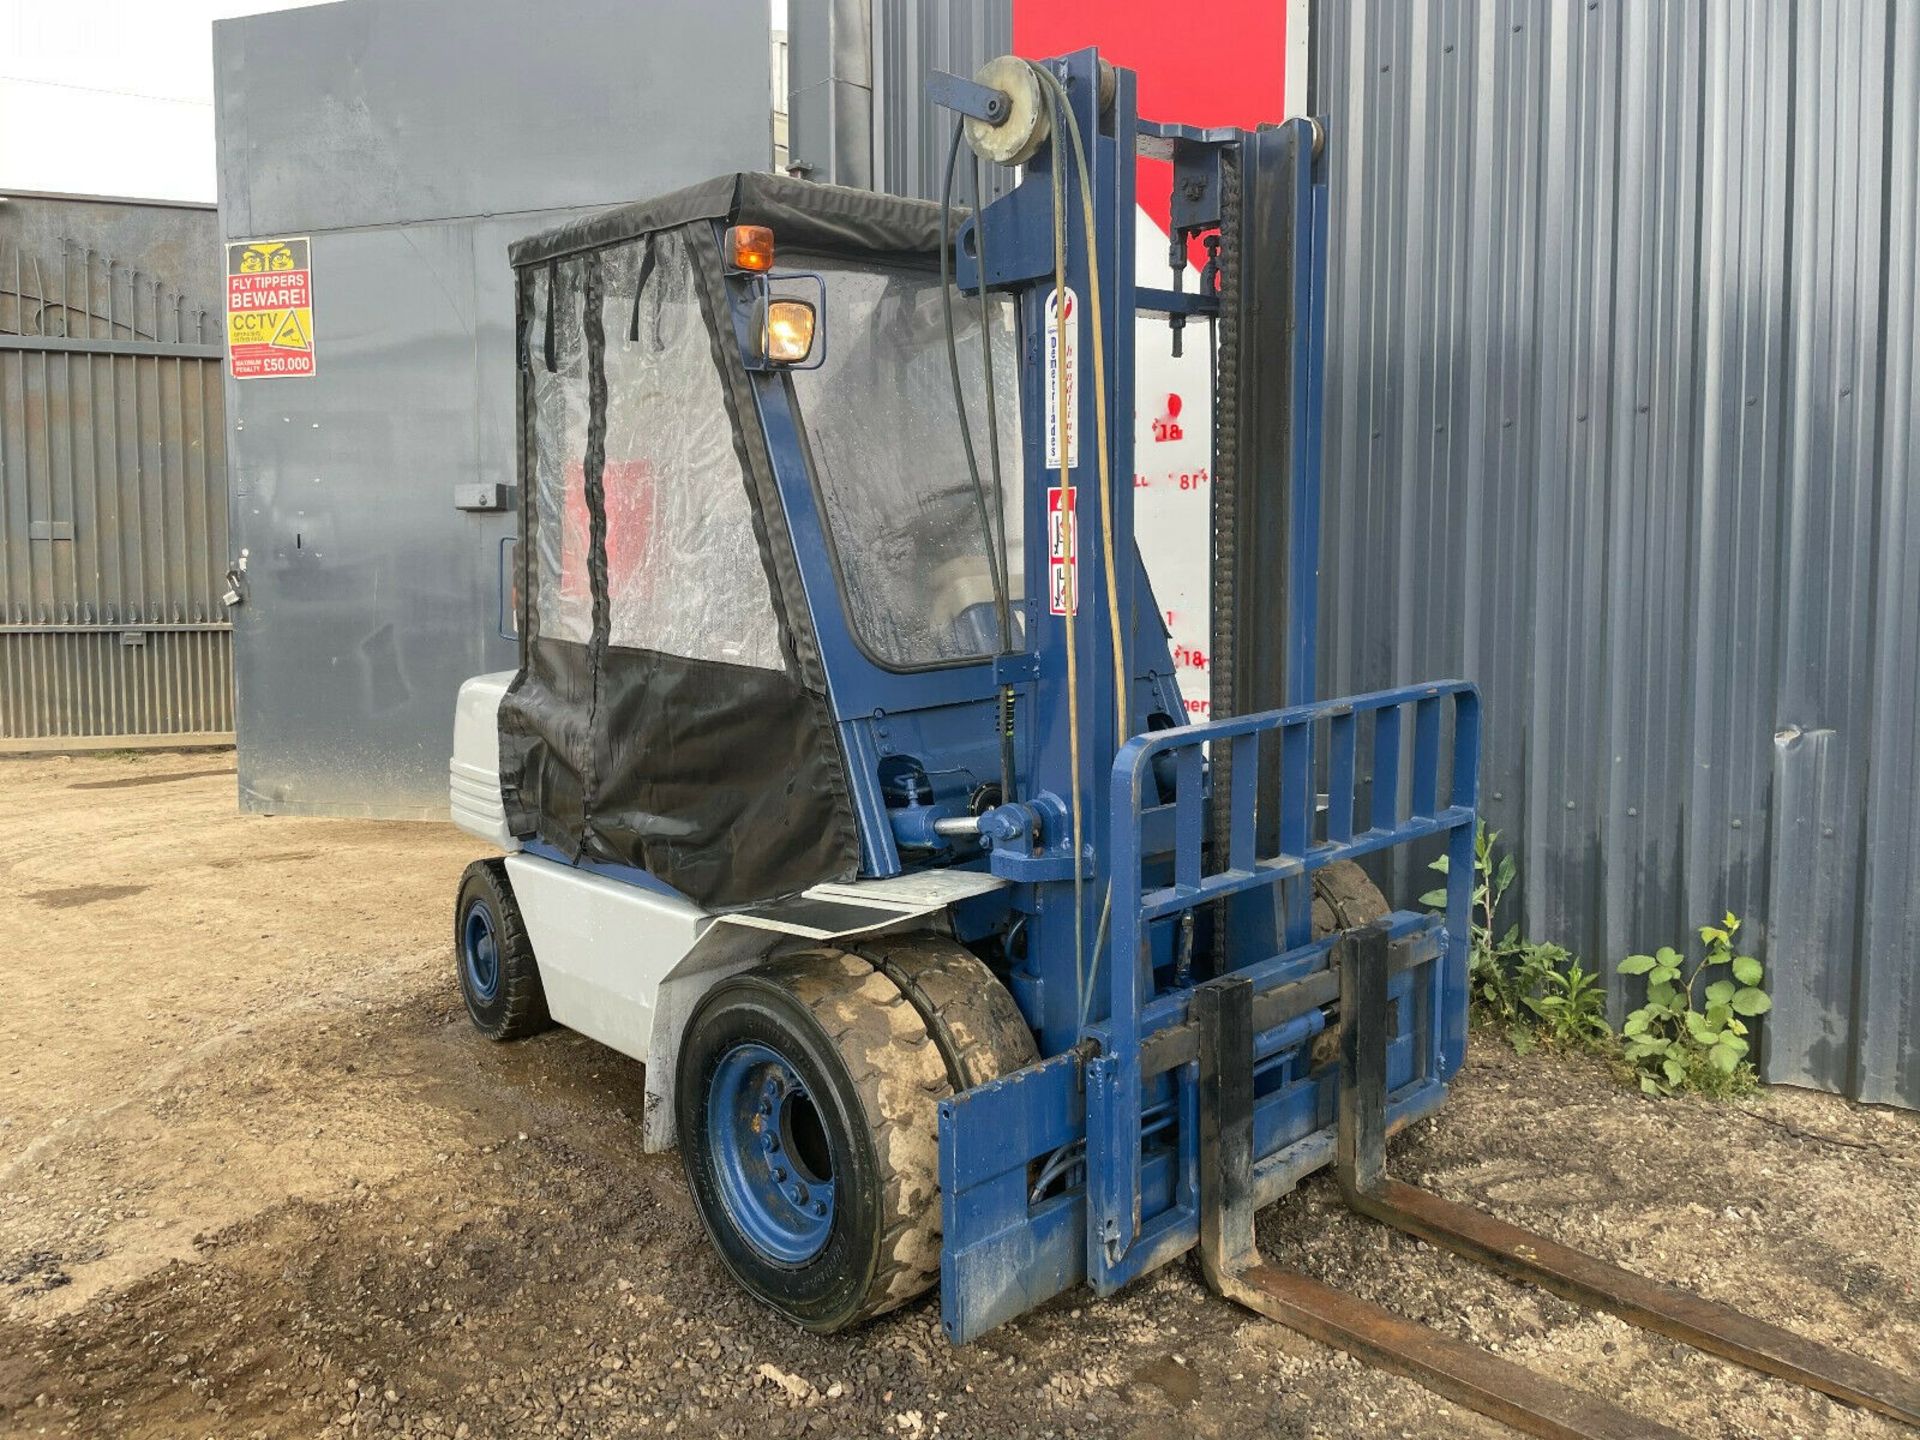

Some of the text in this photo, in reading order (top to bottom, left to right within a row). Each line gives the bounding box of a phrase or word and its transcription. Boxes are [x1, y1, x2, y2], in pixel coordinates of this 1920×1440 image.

[232, 274, 305, 291] FLY TIPPERS
[231, 288, 306, 308] BEWARE!
[233, 313, 278, 330] CCTV
